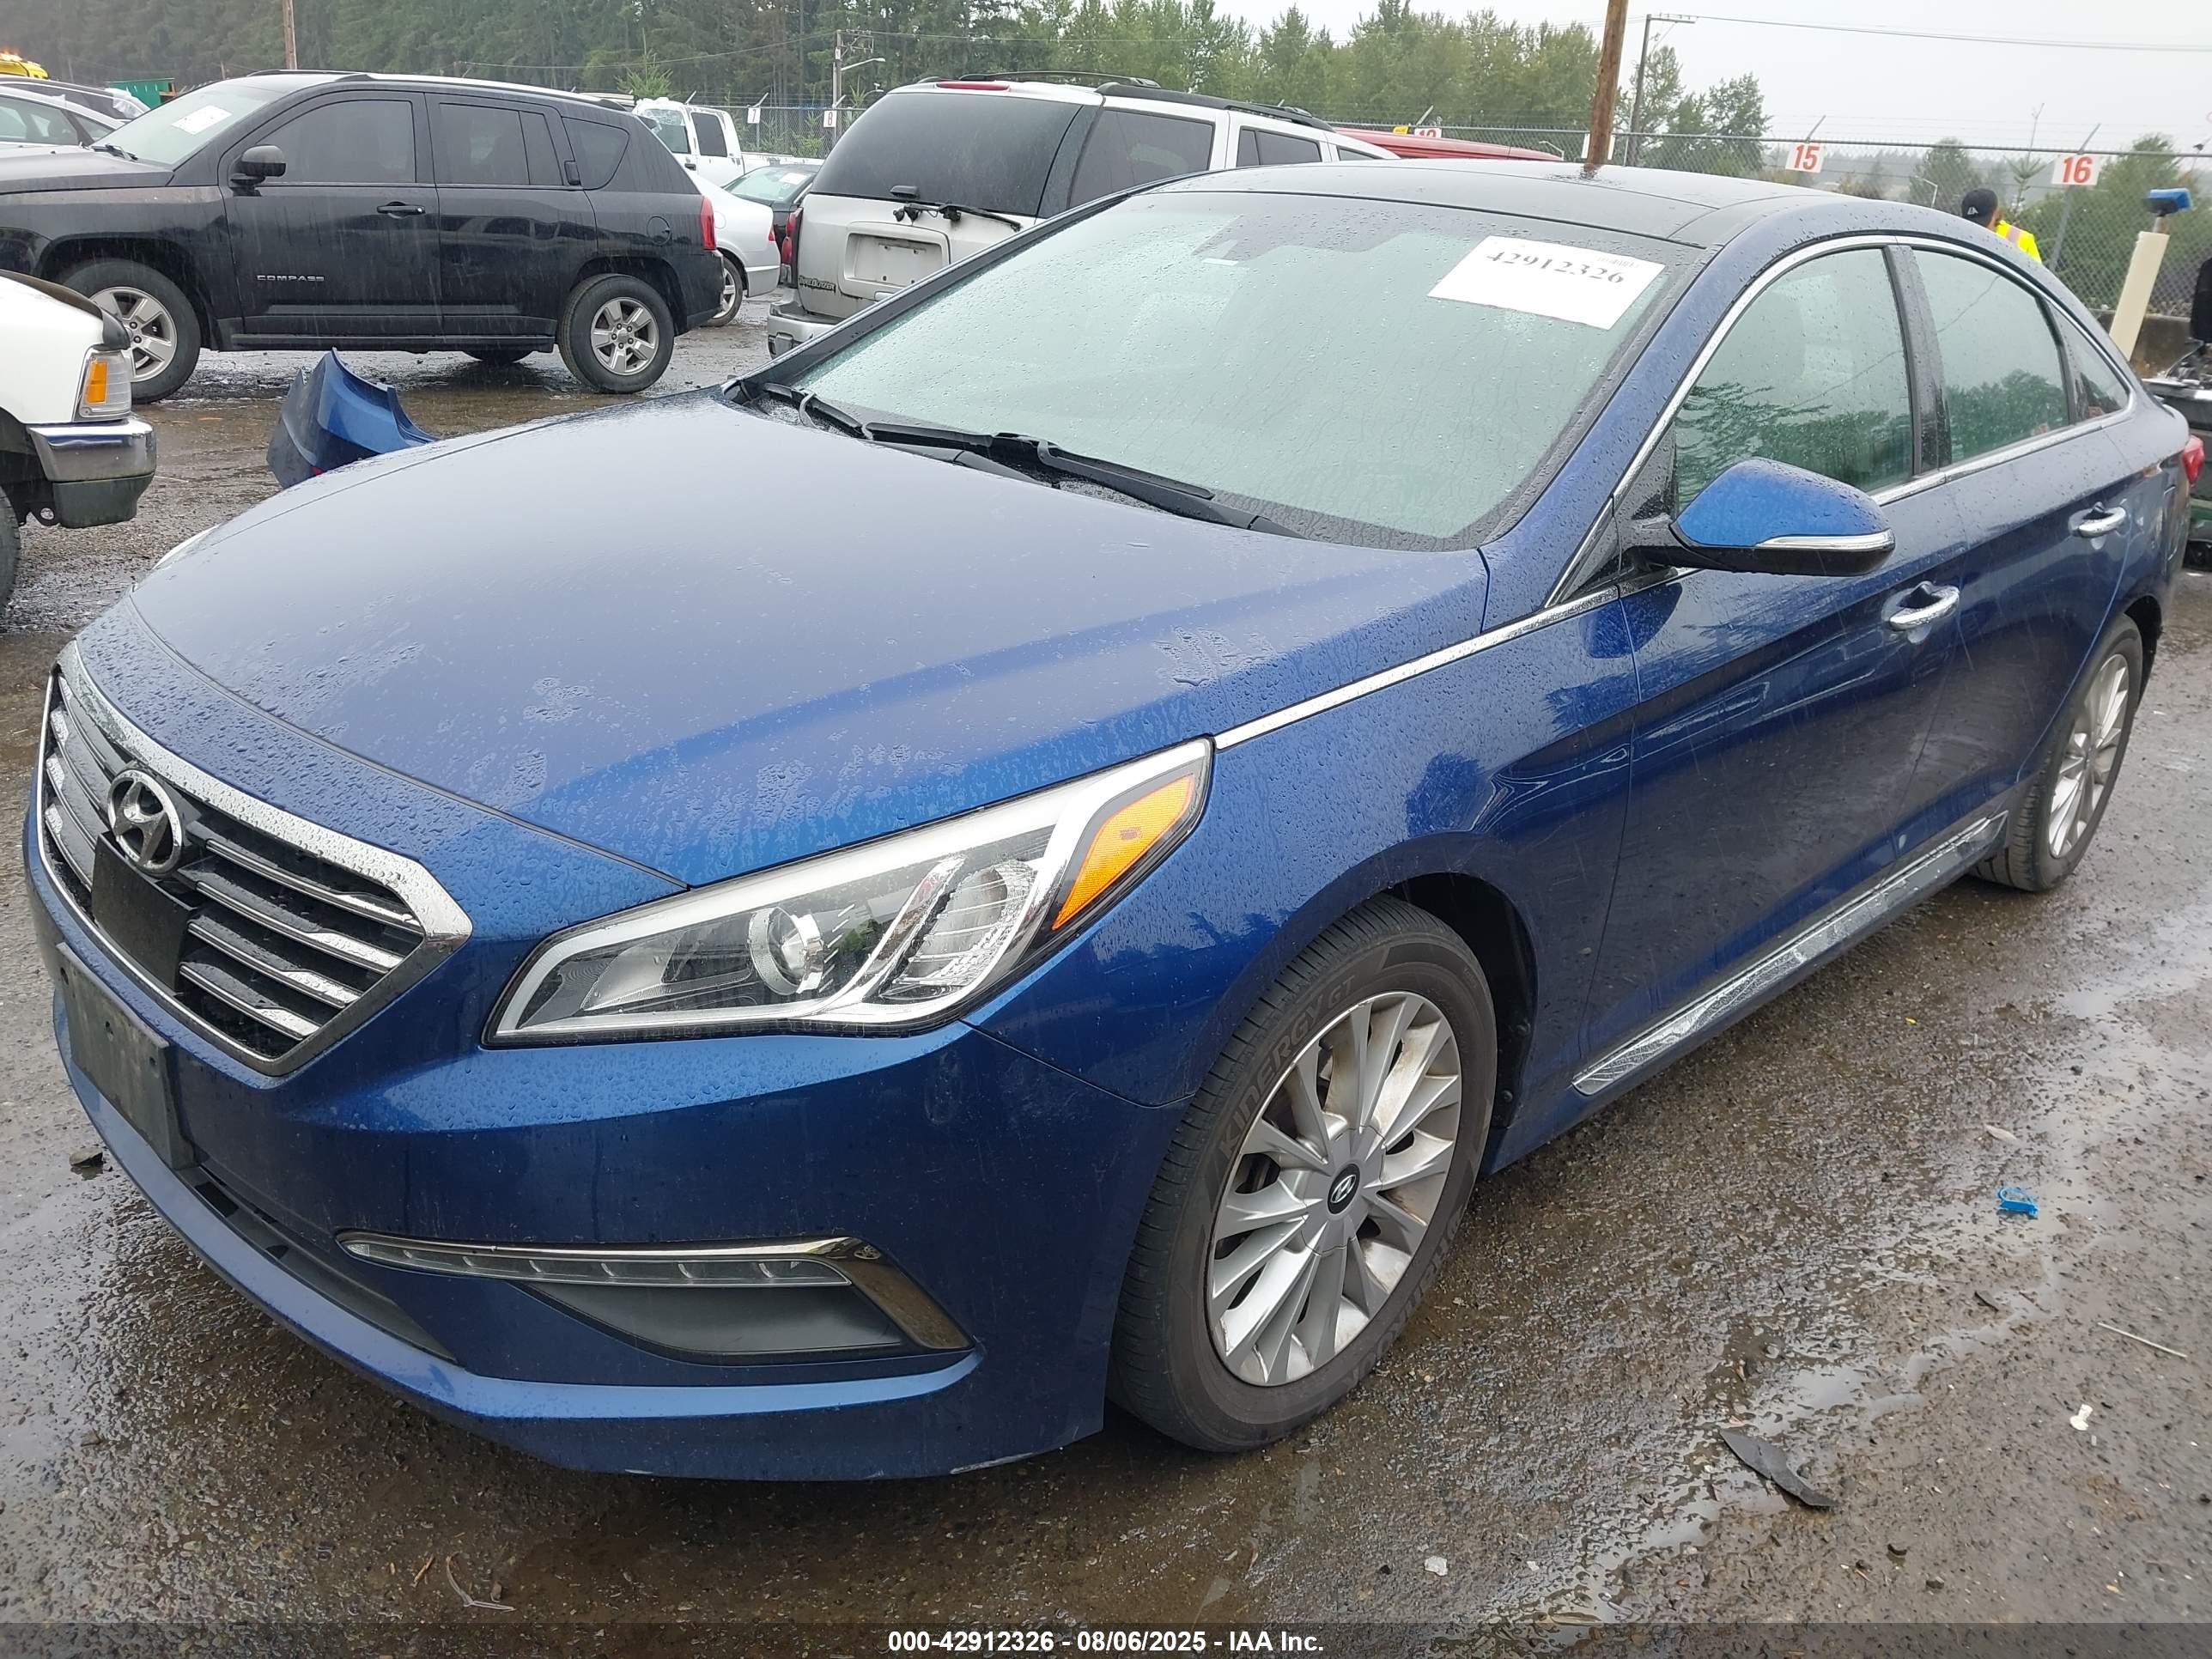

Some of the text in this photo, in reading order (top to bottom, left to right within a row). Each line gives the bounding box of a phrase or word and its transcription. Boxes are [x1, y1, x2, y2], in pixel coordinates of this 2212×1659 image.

[1794, 144, 1820, 170] 15
[2063, 156, 2093, 184] 16
[1486, 251, 1625, 283] 42912326
